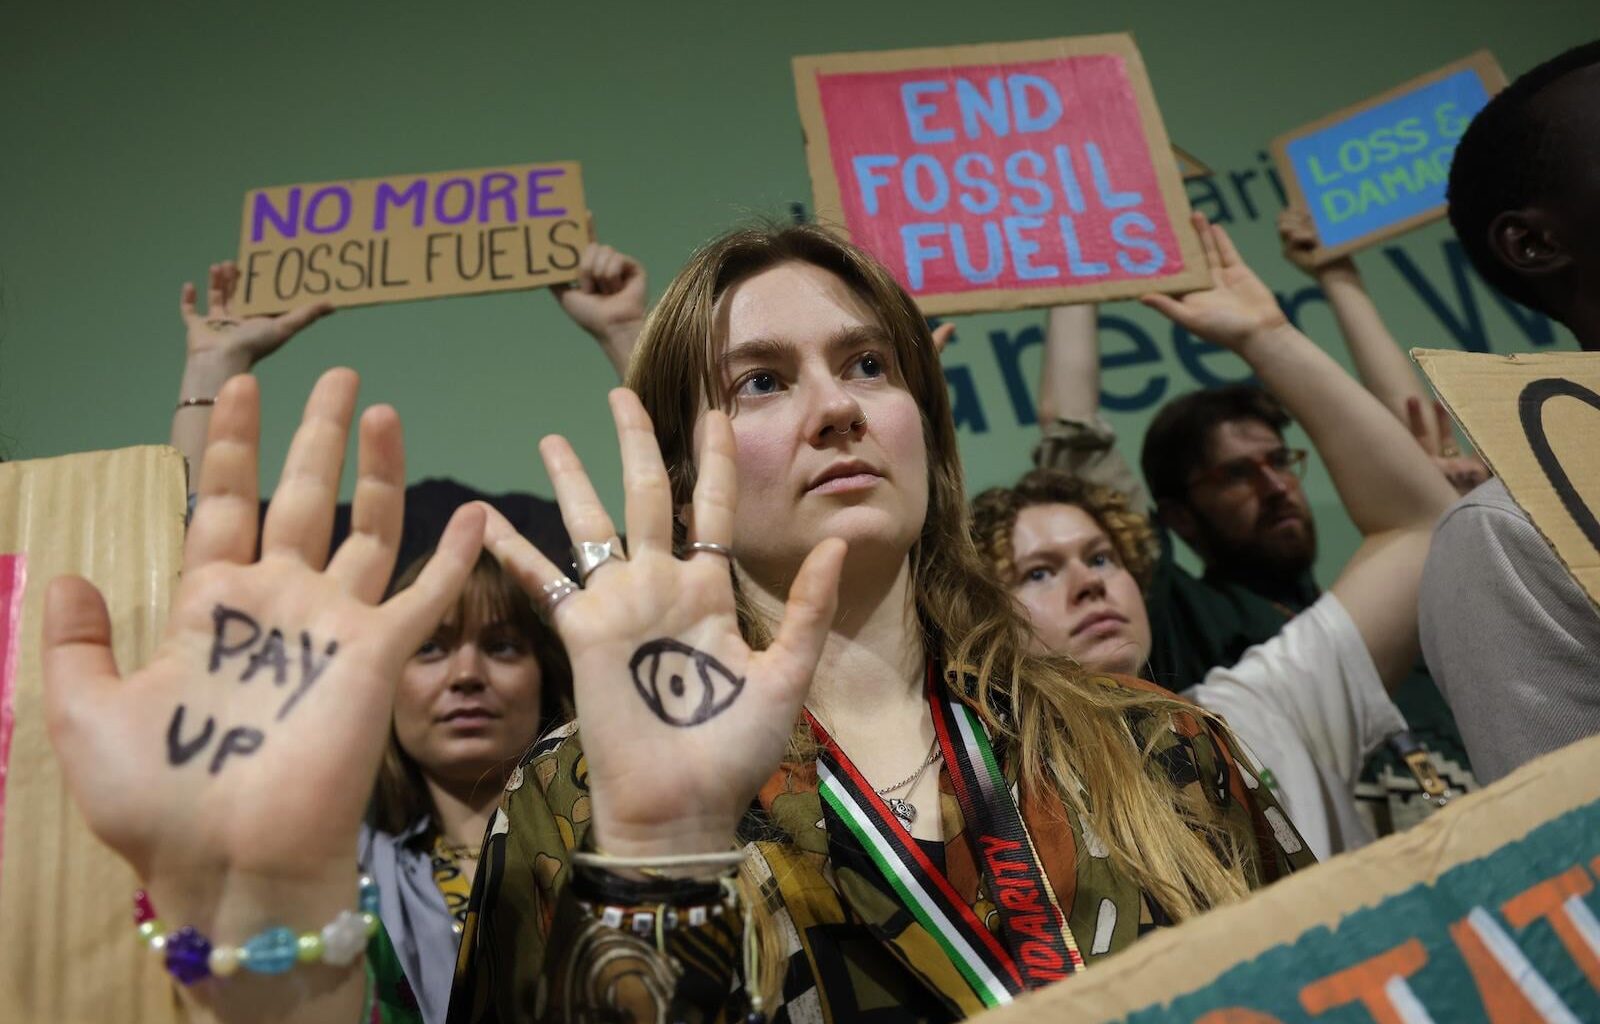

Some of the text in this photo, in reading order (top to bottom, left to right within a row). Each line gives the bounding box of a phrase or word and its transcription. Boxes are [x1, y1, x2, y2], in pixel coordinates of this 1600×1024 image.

[901, 73, 1064, 145] END
[853, 142, 1143, 217] FOSSIL
[1307, 117, 1429, 186] LOSS
[250, 168, 567, 243] NO MORE
[244, 220, 581, 304] FOSSIL FUELS
[899, 211, 1166, 290] FUELS
[208, 604, 340, 722] PAY
[978, 834, 1069, 985] IDARITY
